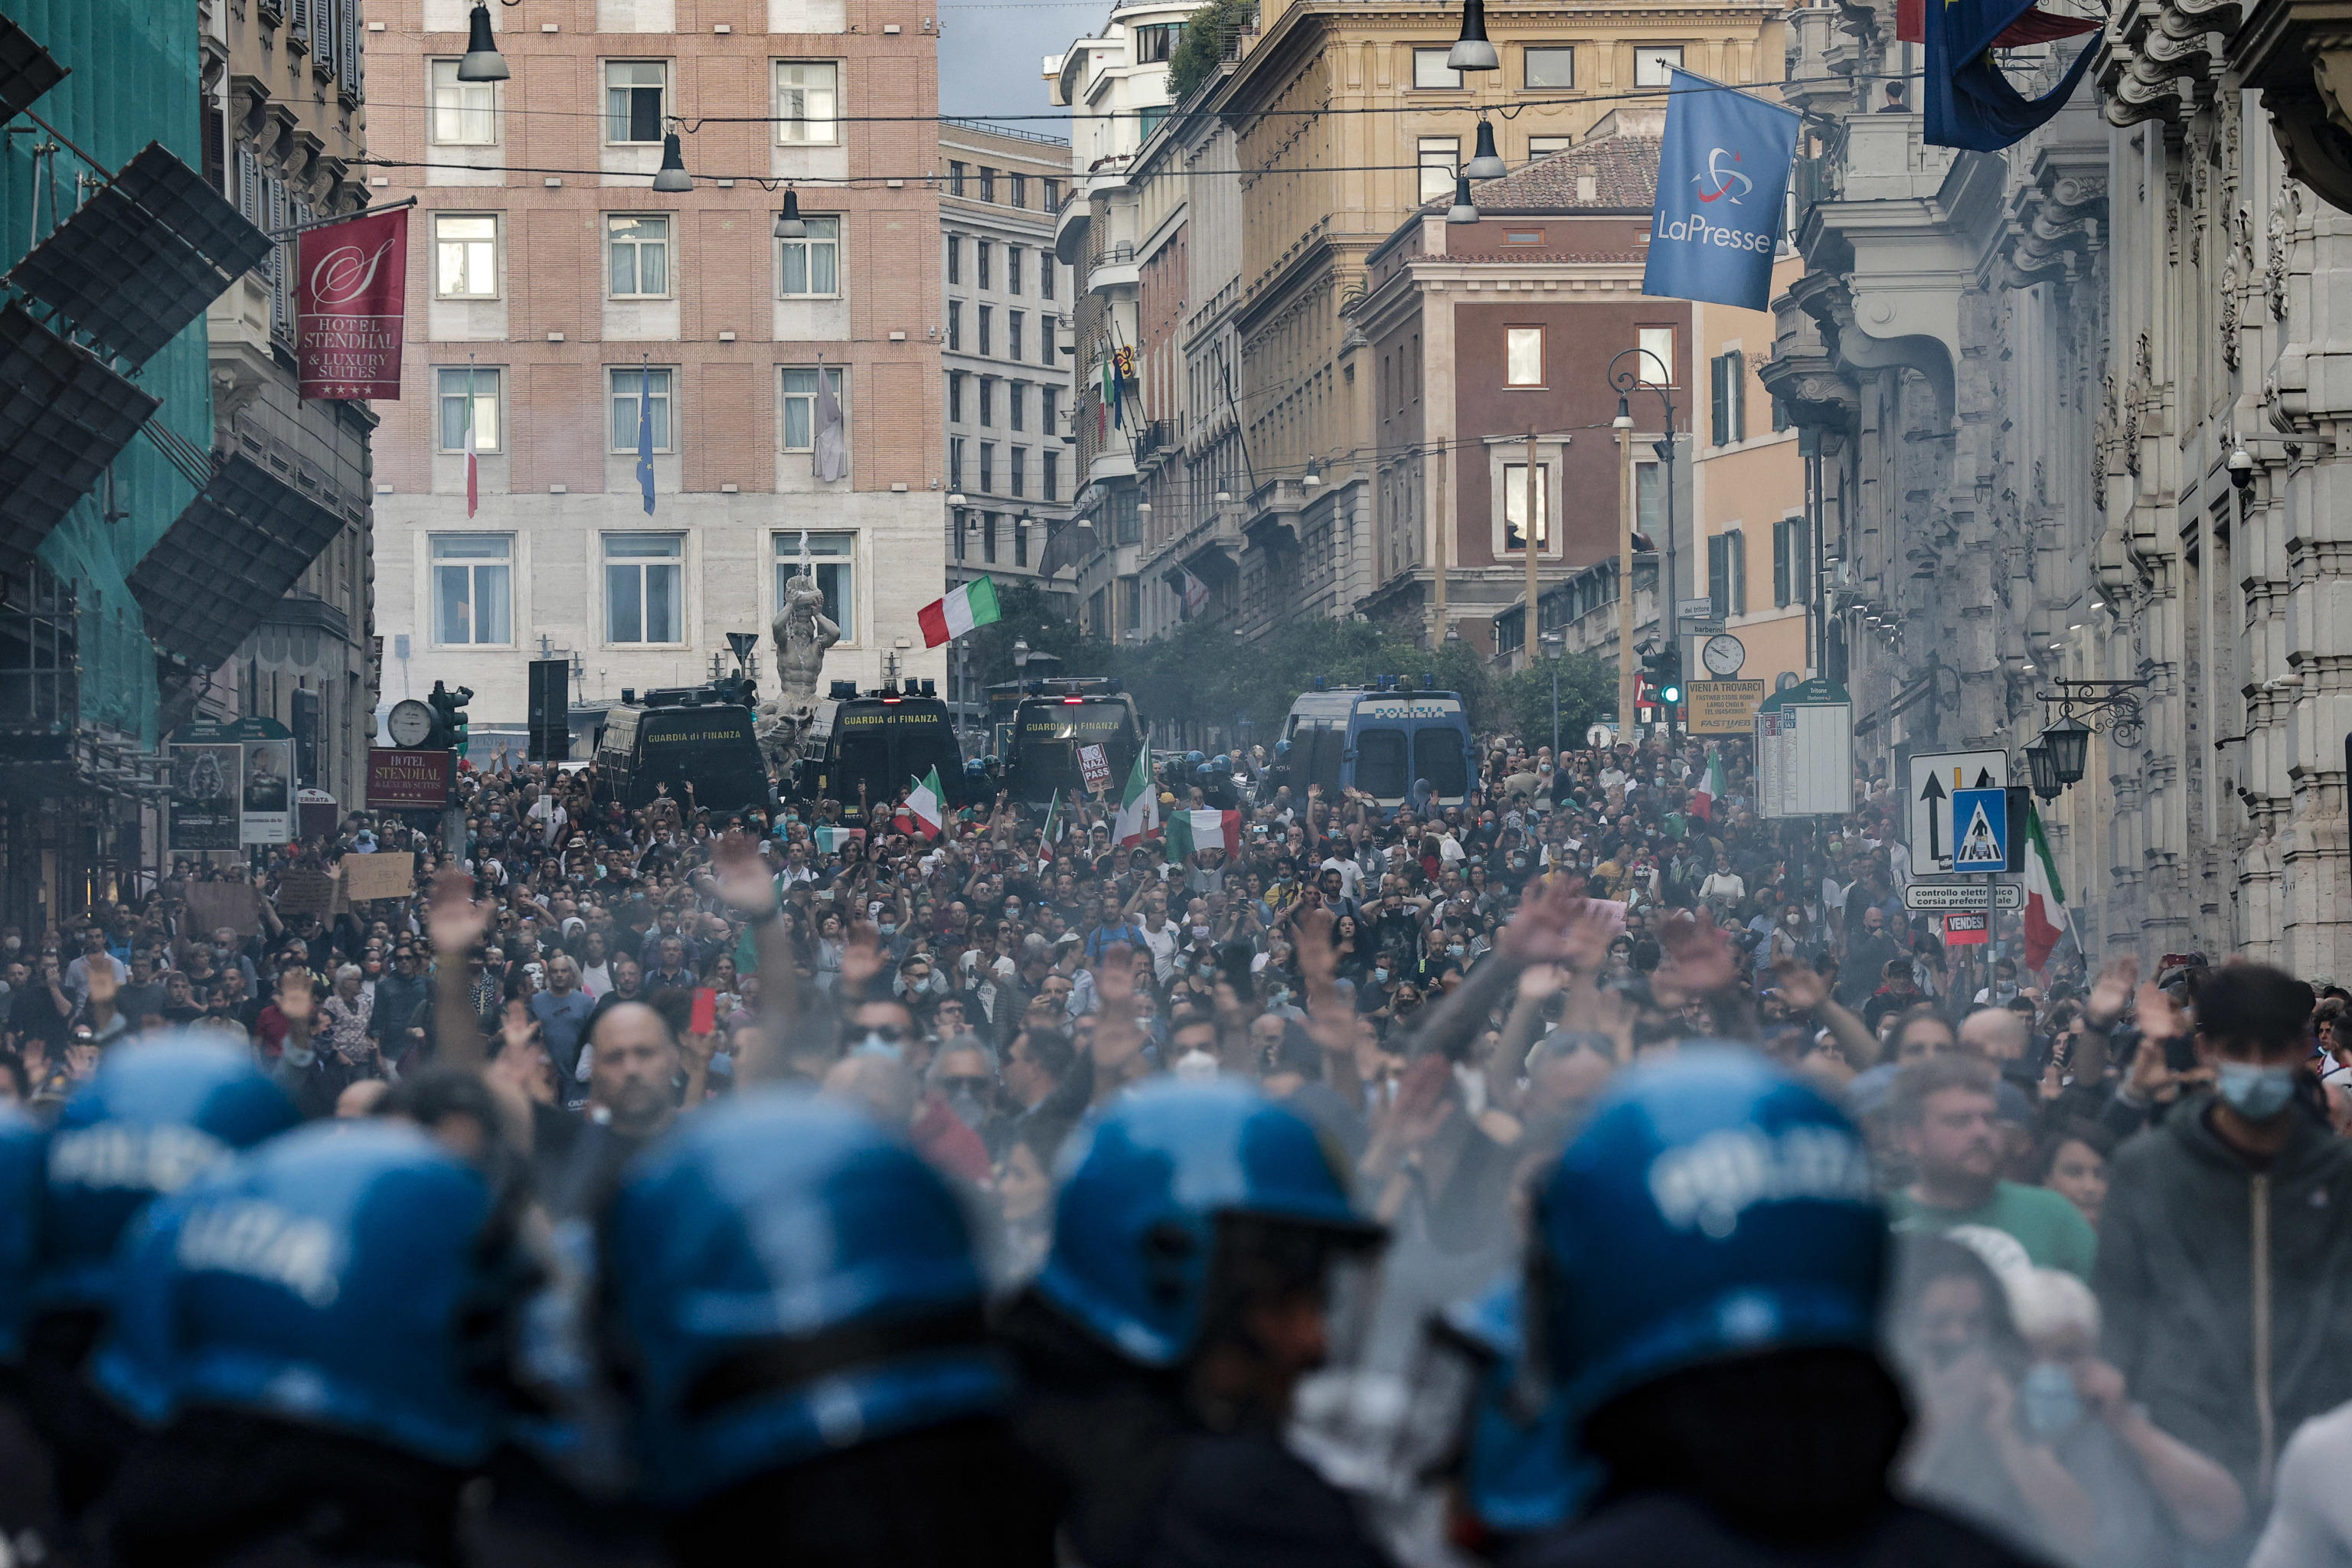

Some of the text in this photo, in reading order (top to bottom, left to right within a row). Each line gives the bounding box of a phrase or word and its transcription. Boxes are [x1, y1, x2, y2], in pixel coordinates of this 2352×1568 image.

[1658, 210, 1771, 253] LaPresse
[318, 318, 380, 332] HOTEL
[304, 333, 395, 349] STENDHAL
[309, 353, 387, 366] & LUXURY
[318, 366, 377, 378] SUITES
[1690, 683, 1761, 692] VIENI A TROVARCI
[844, 714, 938, 725] GUARDIA di FINANZA
[1374, 706, 1446, 720] POLIZIA
[1026, 722, 1065, 731] GUARDIA
[648, 733, 688, 743] GUARDIA
[703, 730, 741, 740] FINANZA
[390, 756, 425, 766] HOTEL
[1083, 757, 1106, 770] NAZI
[375, 766, 440, 780] STENDHAL
[1084, 767, 1109, 780] PASS
[1916, 888, 1958, 897] controllo
[1916, 896, 1947, 905] corsia
[1949, 916, 1984, 930] VENDESI
